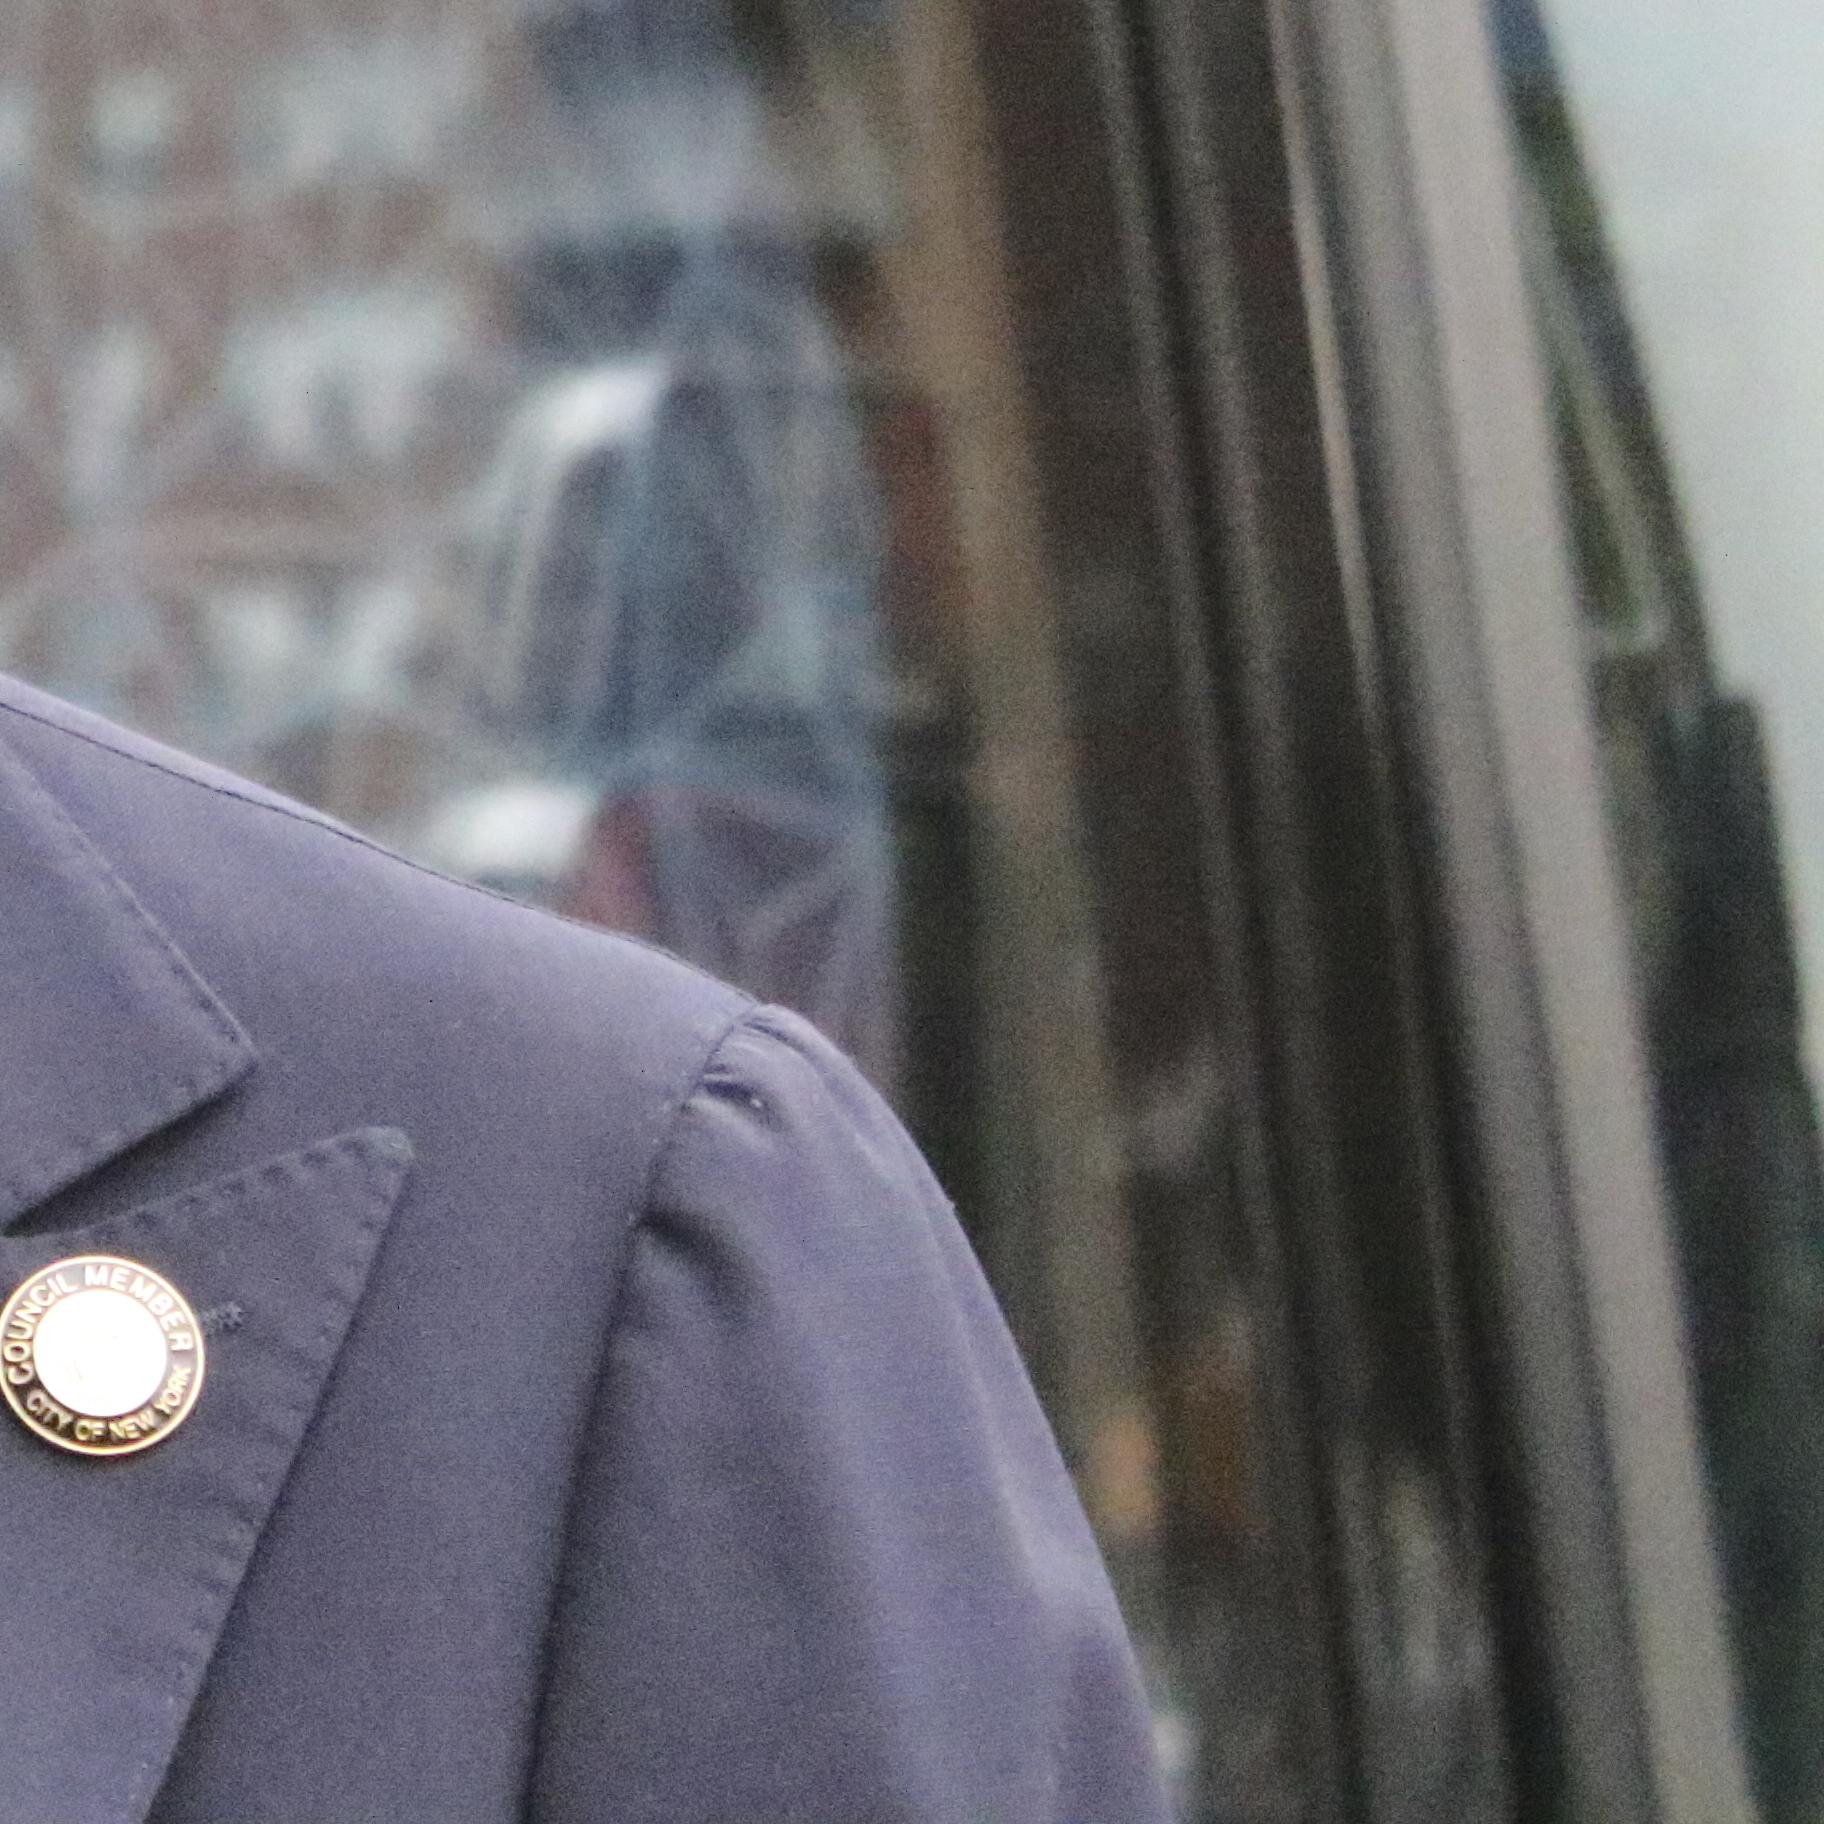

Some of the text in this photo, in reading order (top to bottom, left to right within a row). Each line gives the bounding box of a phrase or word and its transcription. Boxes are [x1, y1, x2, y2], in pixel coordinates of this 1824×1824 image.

[3, 1265, 194, 1385] COUNCIL MEMBER
[26, 1366, 191, 1440] CITY OF NEW YORK
